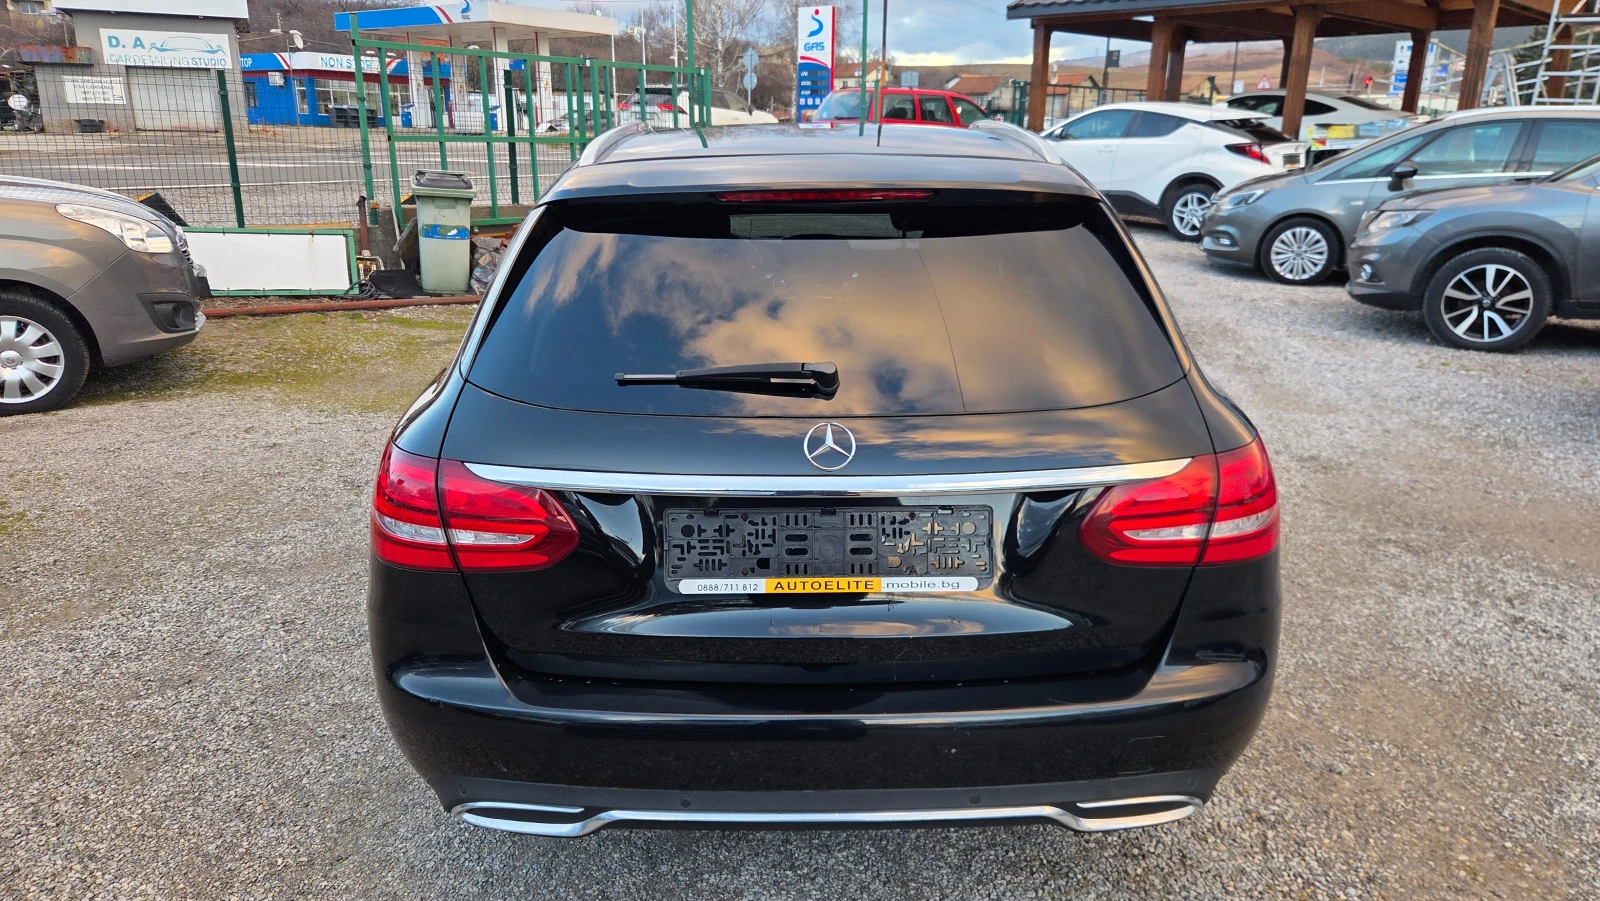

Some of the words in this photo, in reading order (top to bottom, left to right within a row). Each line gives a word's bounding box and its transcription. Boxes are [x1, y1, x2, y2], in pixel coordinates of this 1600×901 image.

[107, 35, 126, 49] D.
[132, 36, 146, 49] A
[803, 41, 825, 52] GAS
[191, 56, 227, 67] STUDIO
[239, 57, 253, 68] TOP
[320, 56, 343, 68] NON
[345, 58, 372, 70] SOP
[697, 583, 739, 592] 0888/711
[742, 583, 758, 591] 812
[773, 580, 874, 591] AUTOELITE
